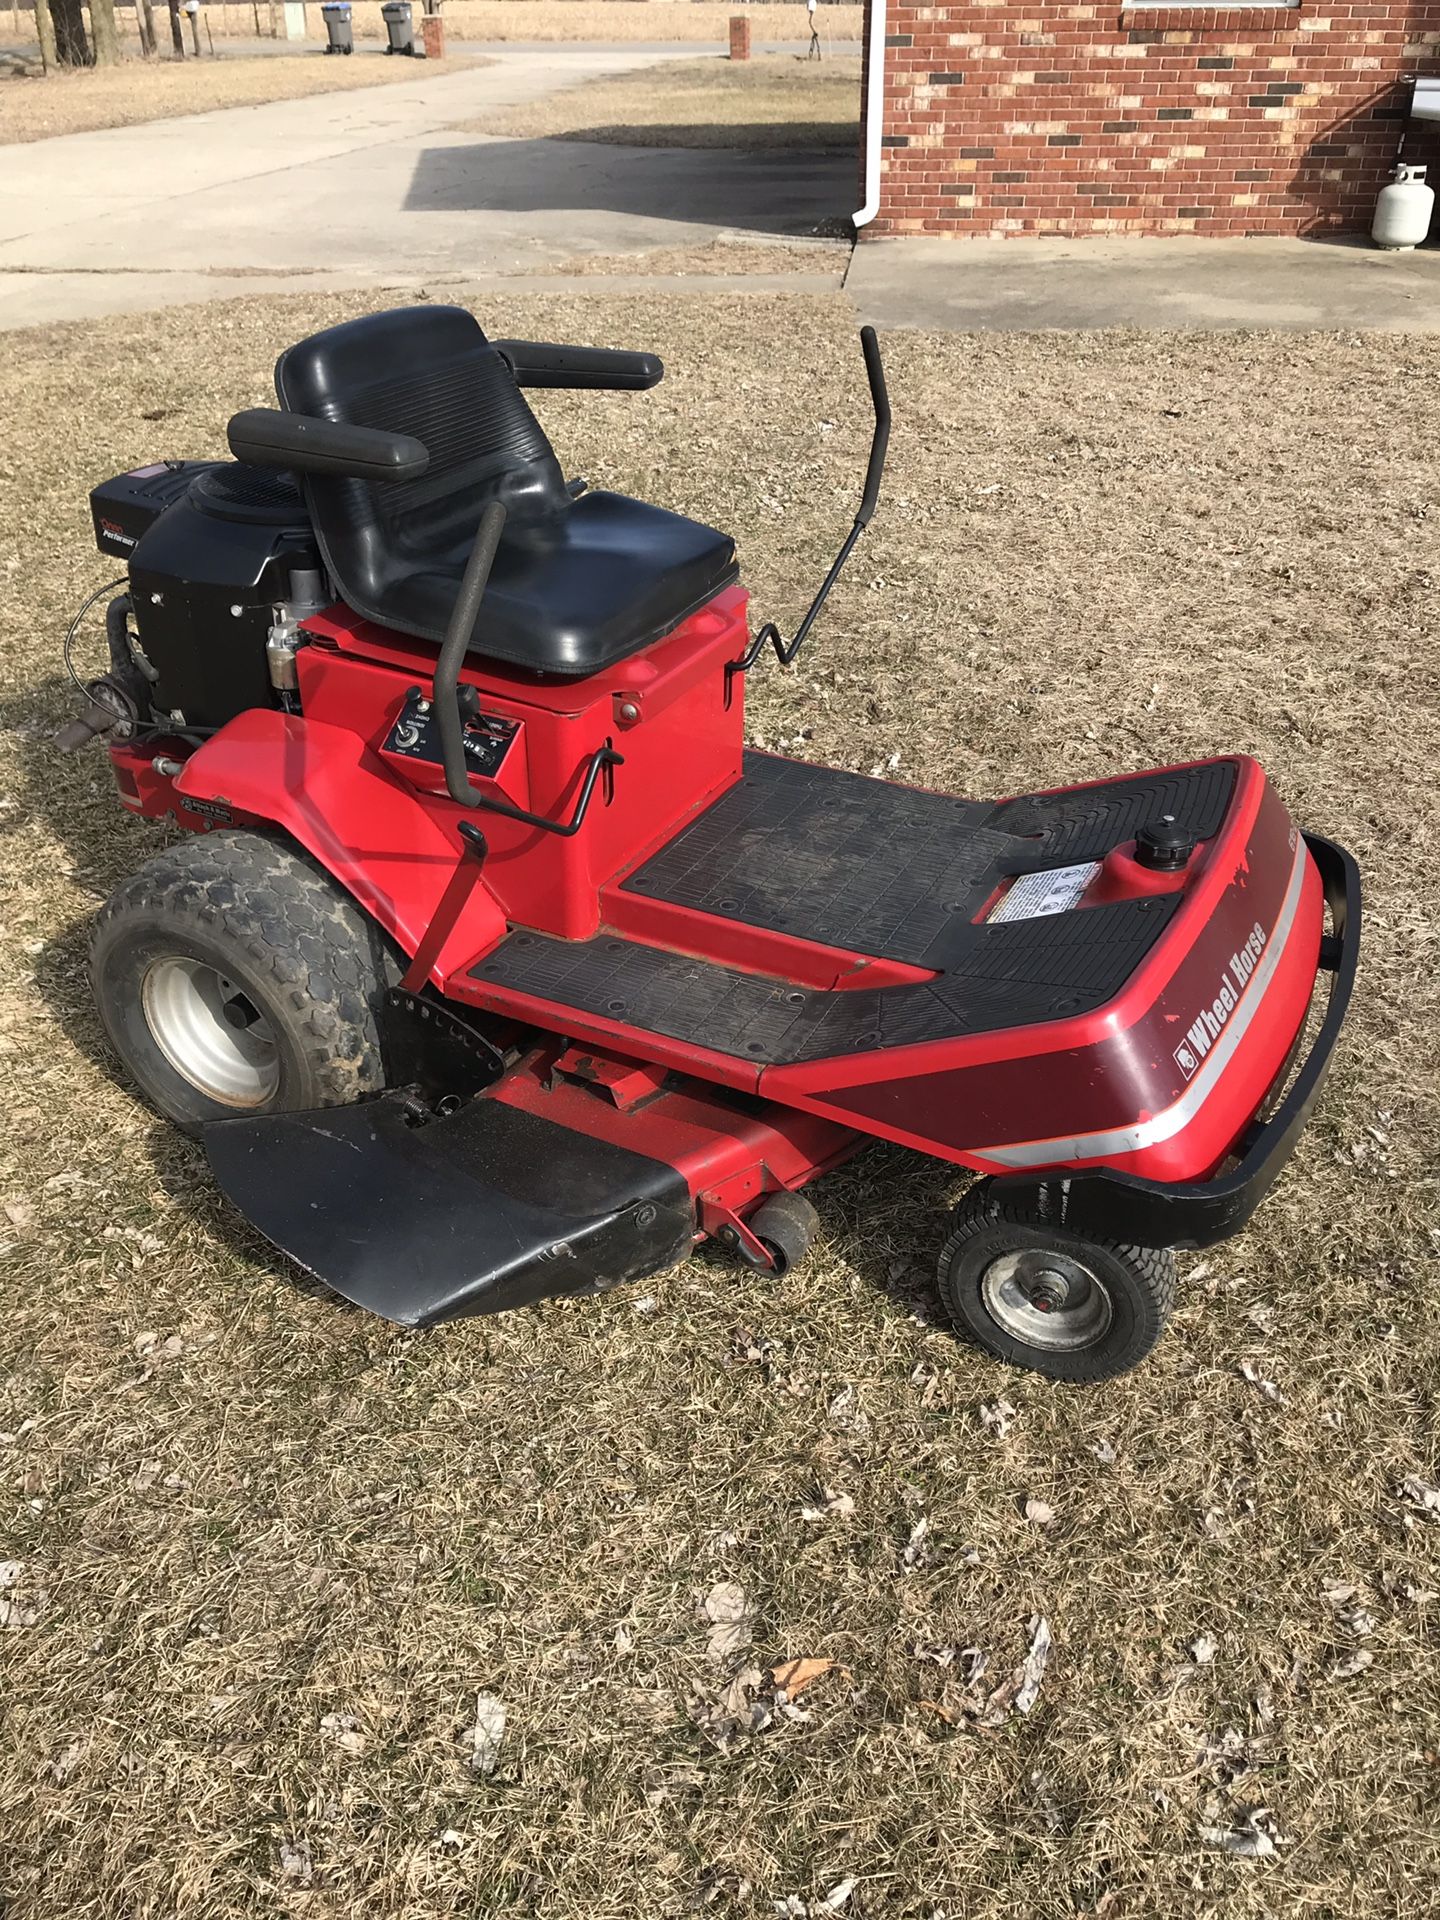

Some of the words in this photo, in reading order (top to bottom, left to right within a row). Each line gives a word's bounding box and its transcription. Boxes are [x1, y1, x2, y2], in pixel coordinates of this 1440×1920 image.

[103, 529, 135, 547] Performer
[1187, 973, 1239, 1058] Wheel
[1229, 921, 1268, 989] Horse
